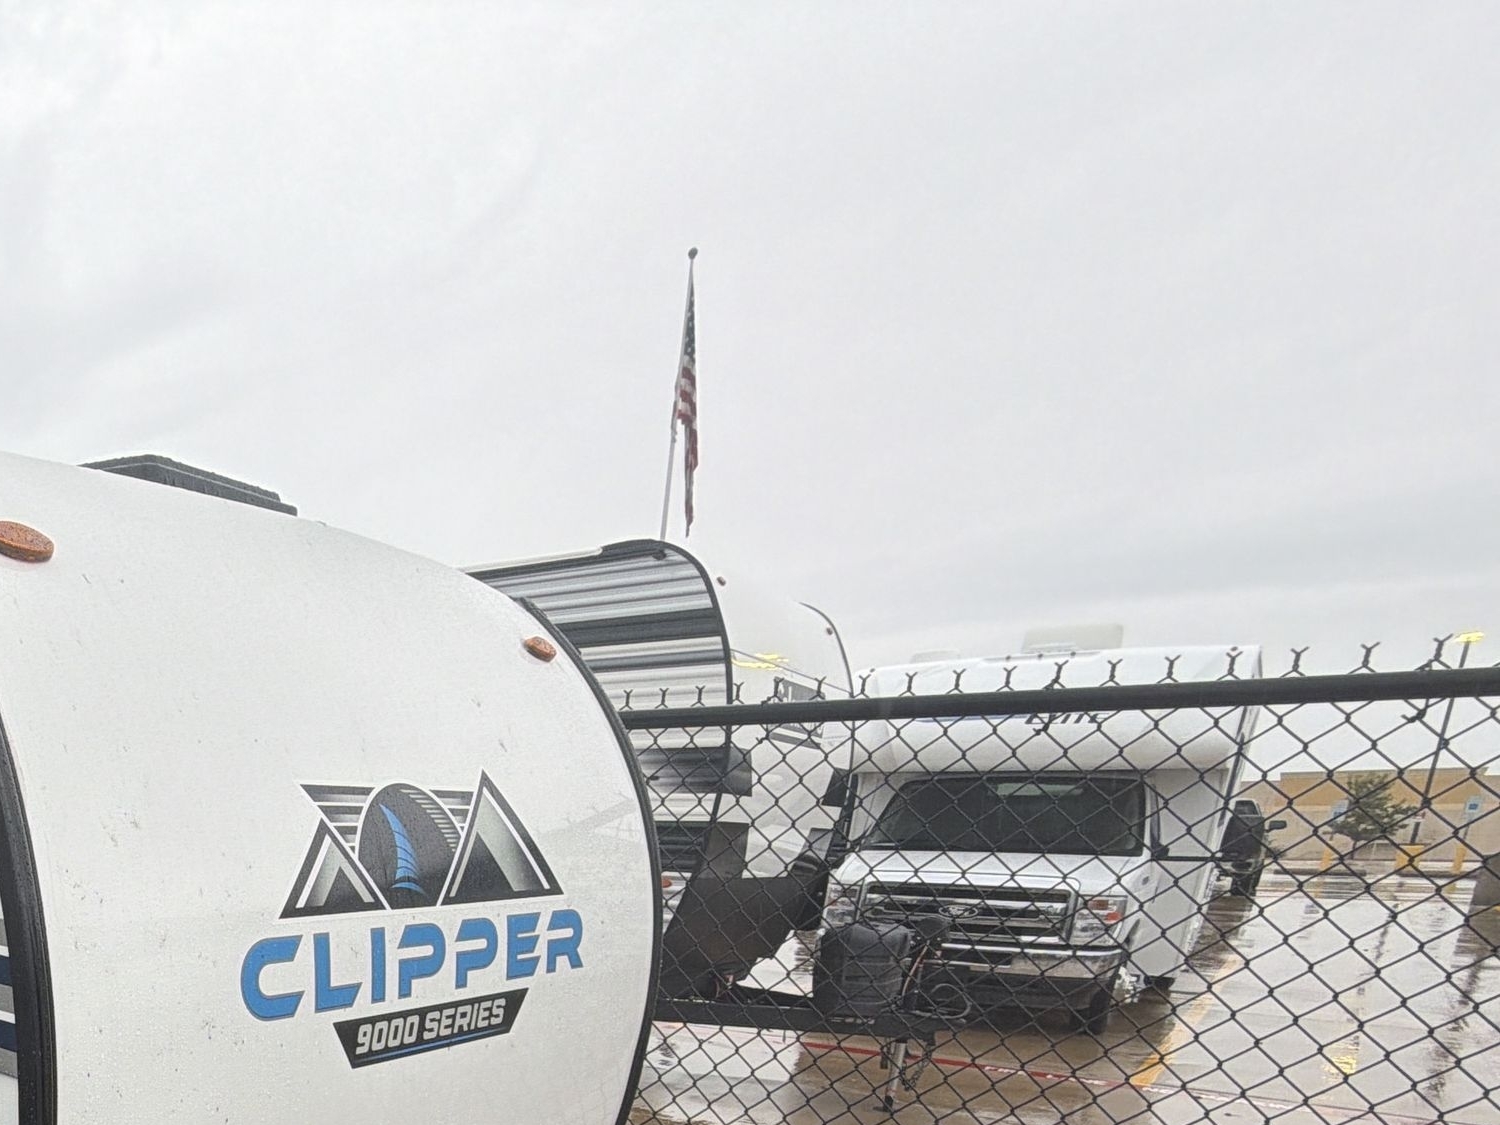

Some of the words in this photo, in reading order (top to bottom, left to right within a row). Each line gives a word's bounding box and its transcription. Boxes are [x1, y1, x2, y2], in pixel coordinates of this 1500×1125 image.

[240, 908, 584, 1022] CLIPPER
[356, 1014, 420, 1055] 9000
[422, 998, 506, 1041] SERIES
